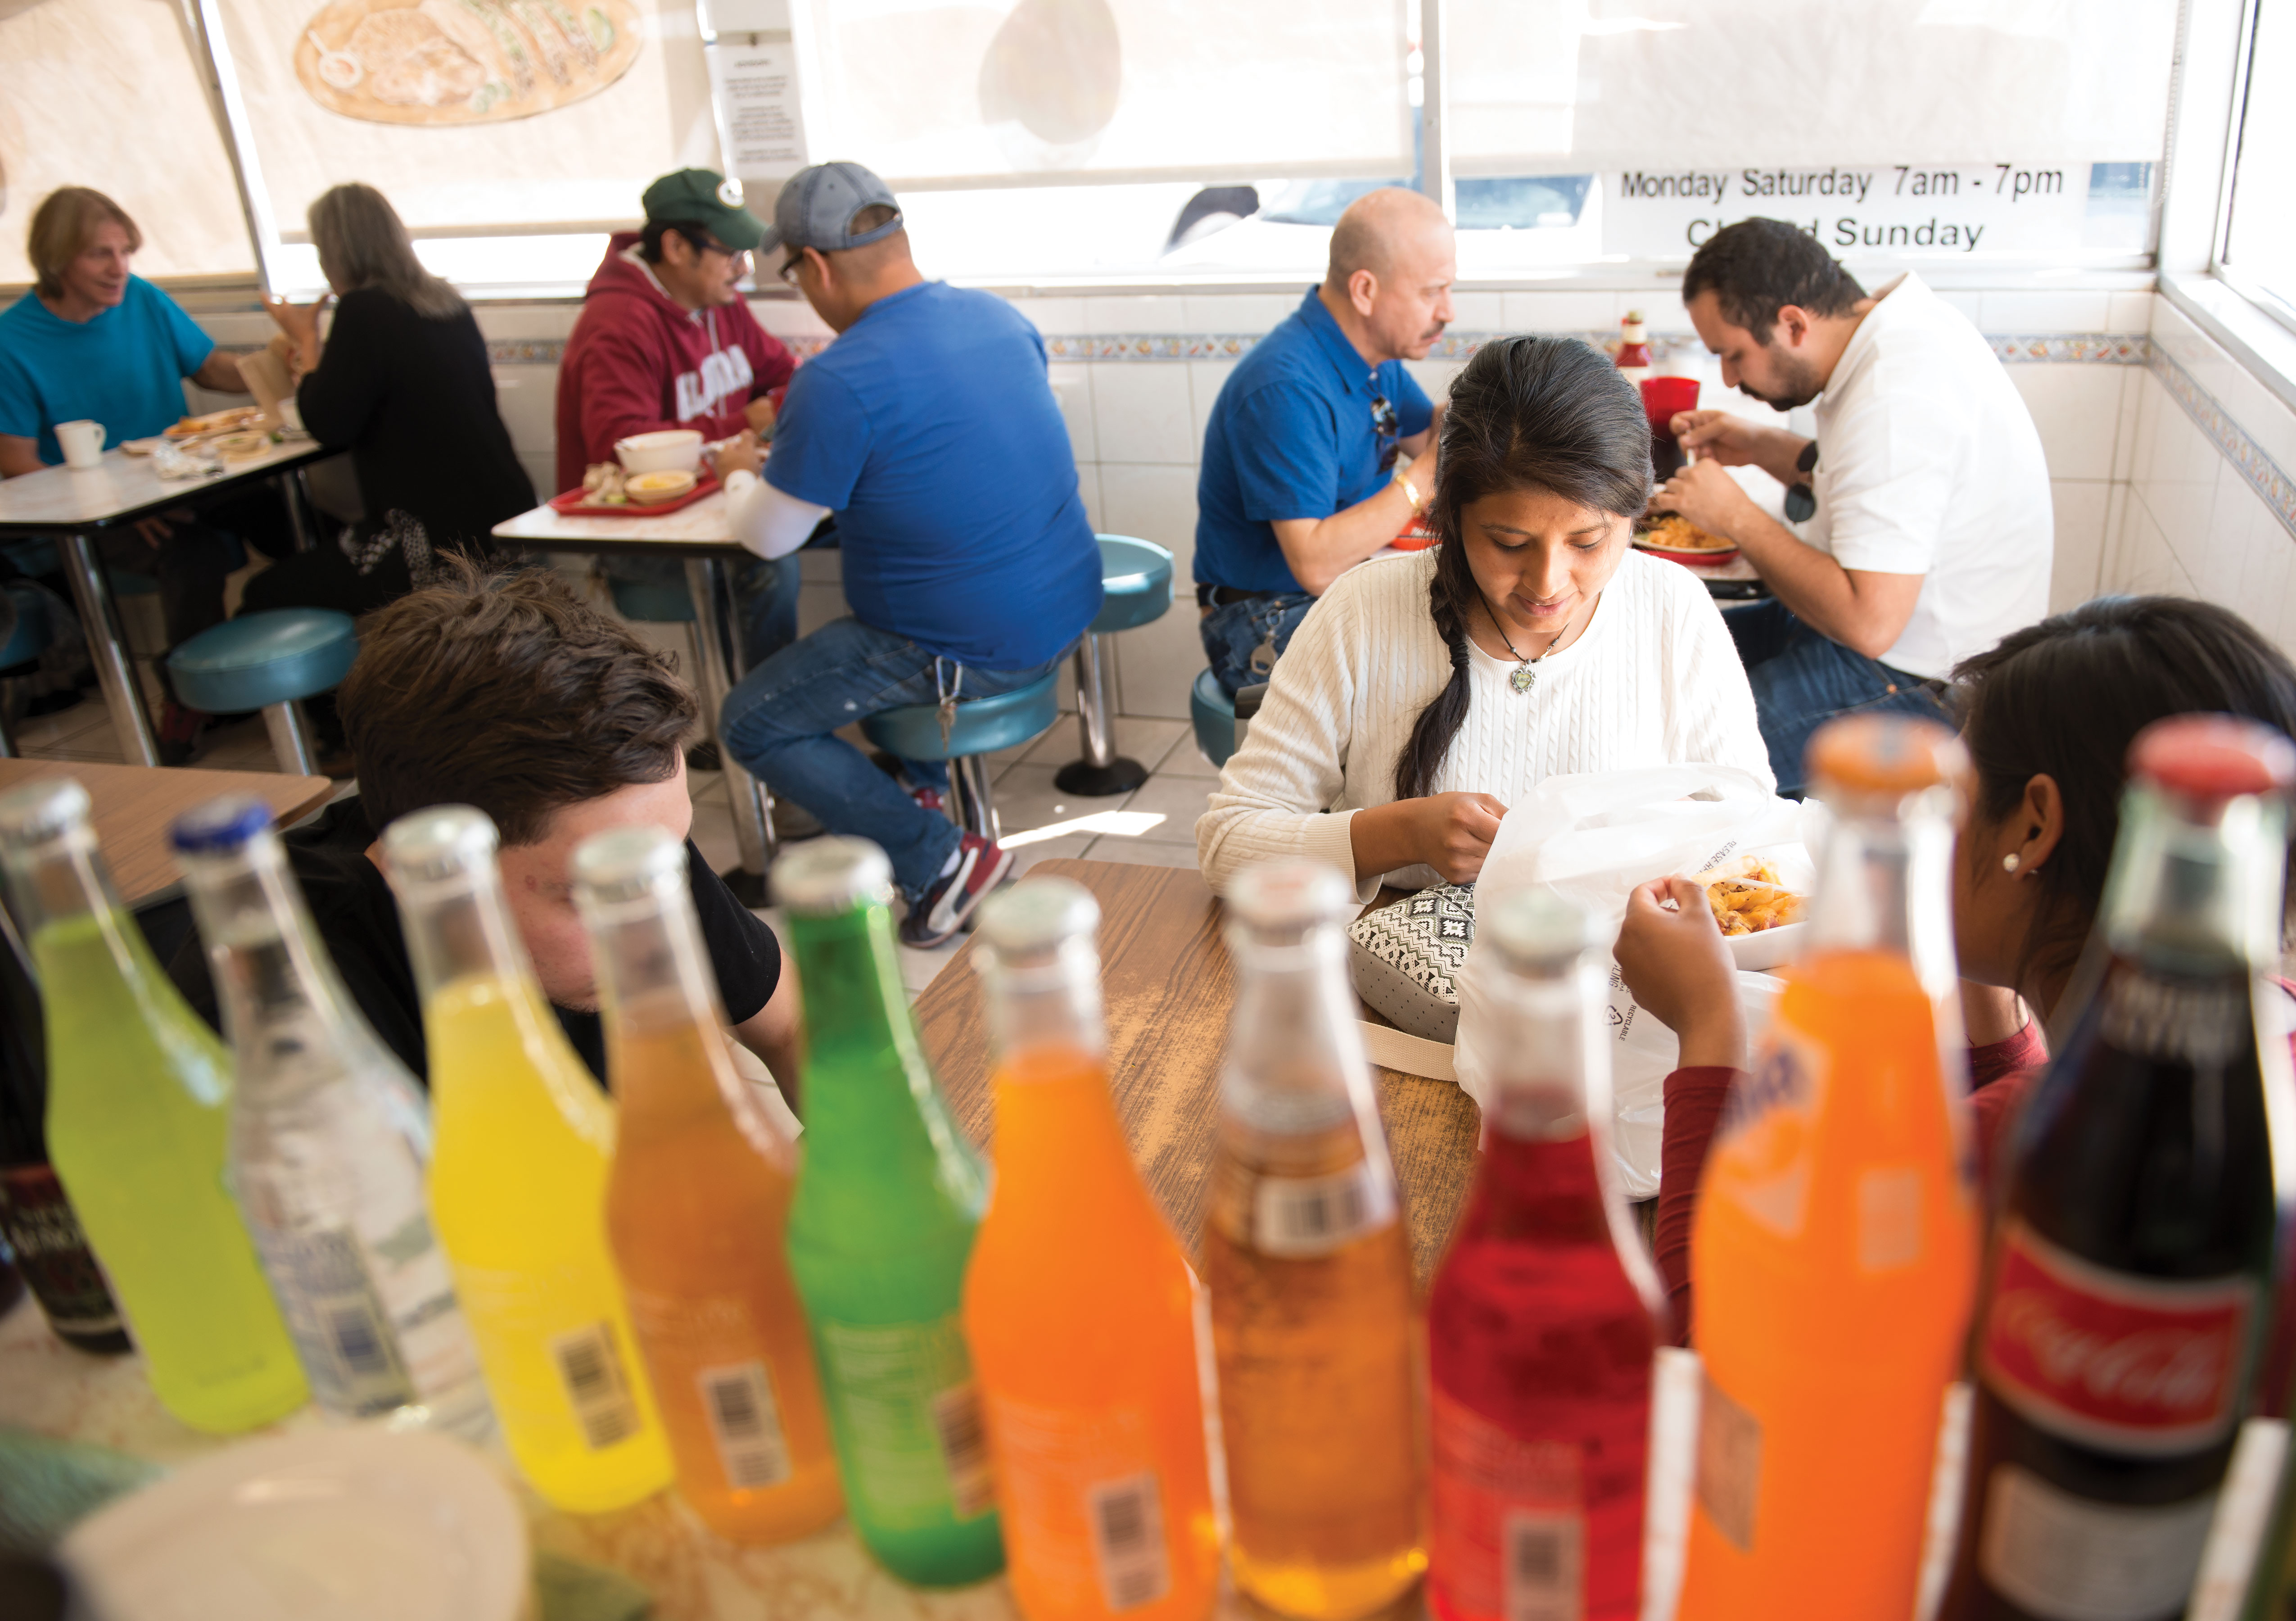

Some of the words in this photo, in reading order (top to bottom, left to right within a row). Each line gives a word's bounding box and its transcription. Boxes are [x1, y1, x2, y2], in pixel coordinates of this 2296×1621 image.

[1622, 170, 1728, 204] Monday
[1742, 167, 1873, 203] Saturday
[1894, 166, 1958, 195] 7am
[1996, 163, 2062, 202] 7pm
[1835, 217, 1984, 252] Sunday
[1618, 1005, 1637, 1041] RECYCLABLE
